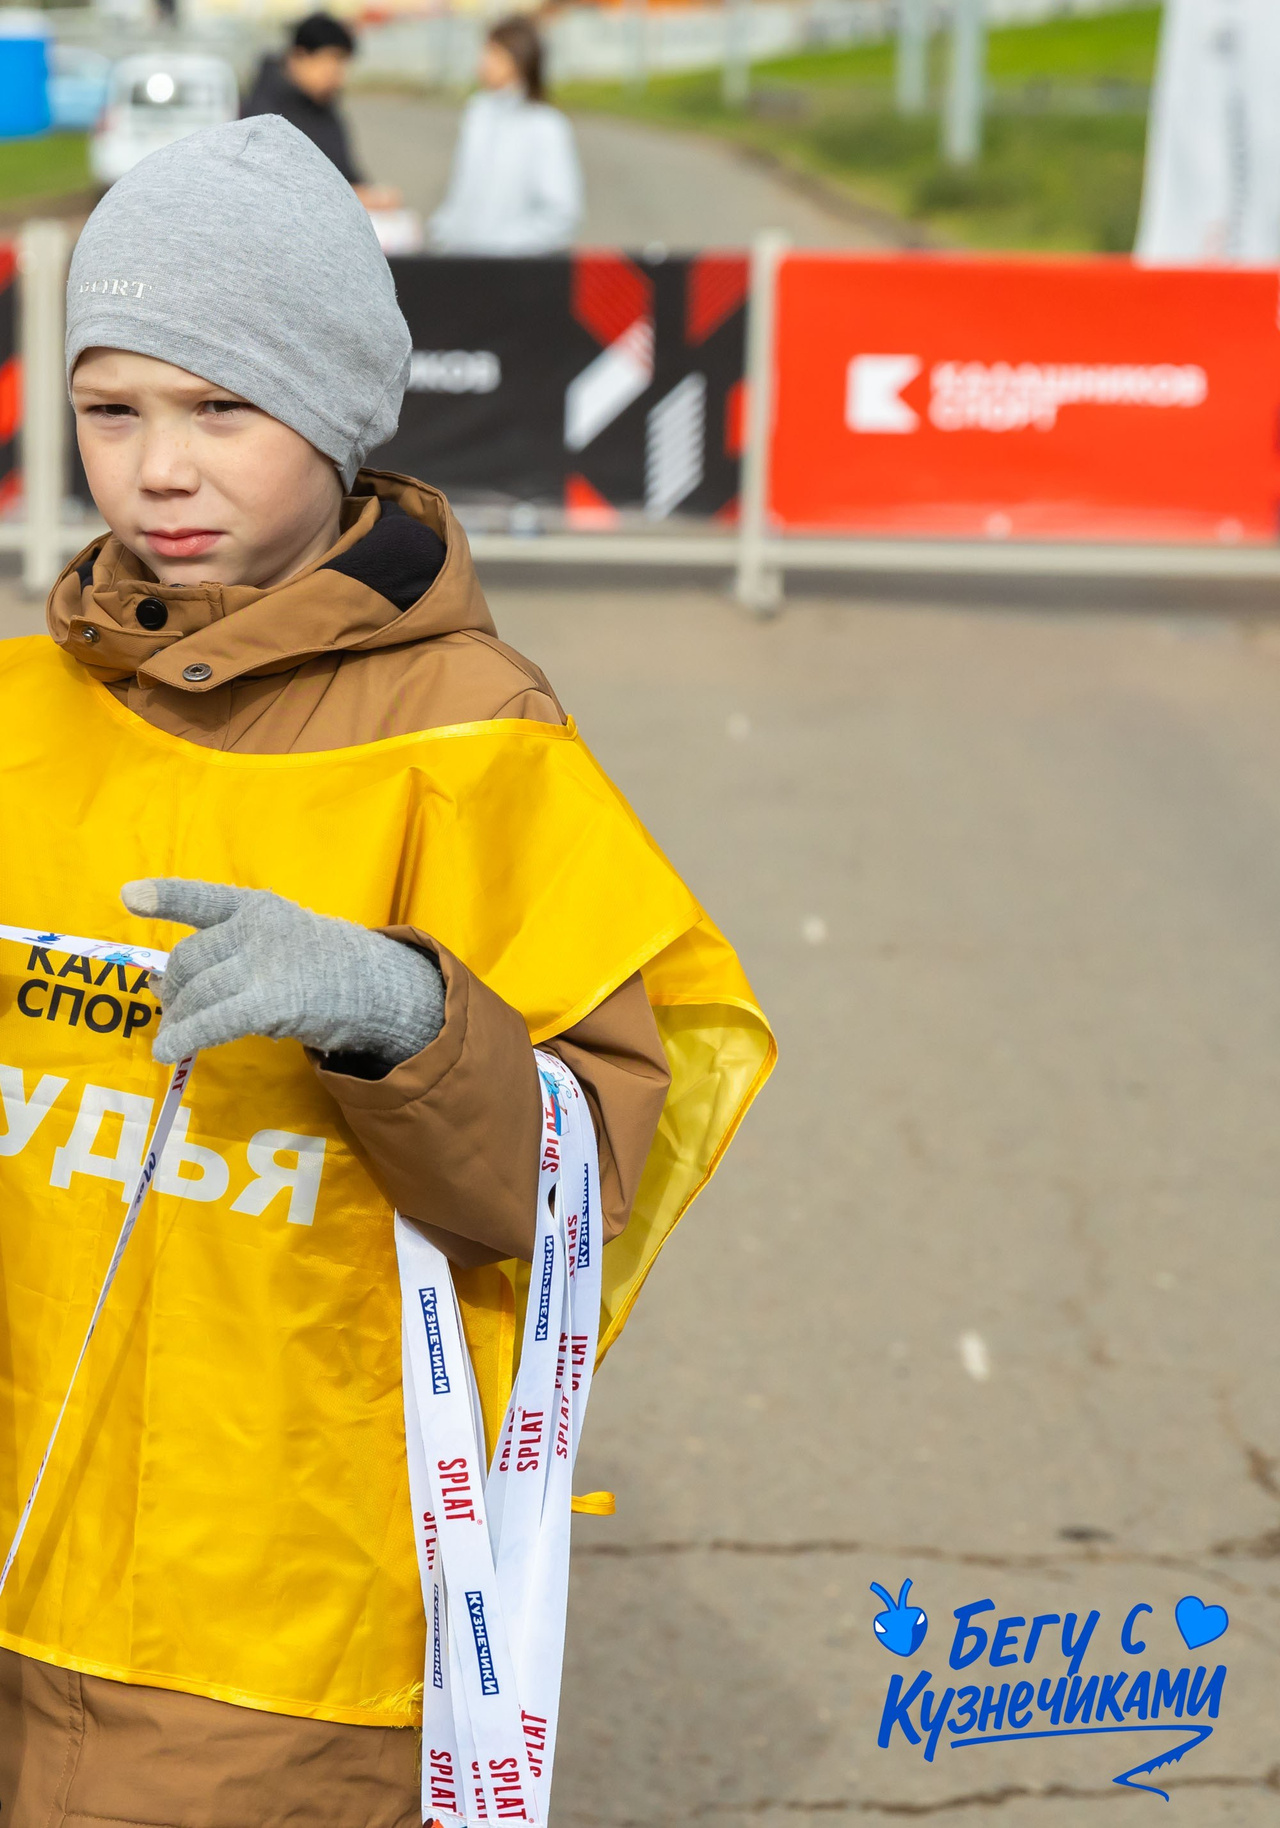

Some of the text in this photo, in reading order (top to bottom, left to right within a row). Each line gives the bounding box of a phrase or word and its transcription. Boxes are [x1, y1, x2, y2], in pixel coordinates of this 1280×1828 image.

[18, 978, 162, 1038] СПОР
[535, 1235, 554, 1341] КУЗНЕЧИКИ
[419, 1287, 450, 1394] КУЗНЕЧИКИ
[517, 1410, 543, 1471] SPLAT
[556, 1394, 570, 1459] SPLAT
[438, 1458, 475, 1521] SPLAT
[465, 1590, 499, 1695] КУЗНЕЧИКИ
[430, 1749, 457, 1813] SPLAT
[489, 1758, 527, 1820] SPLAT
